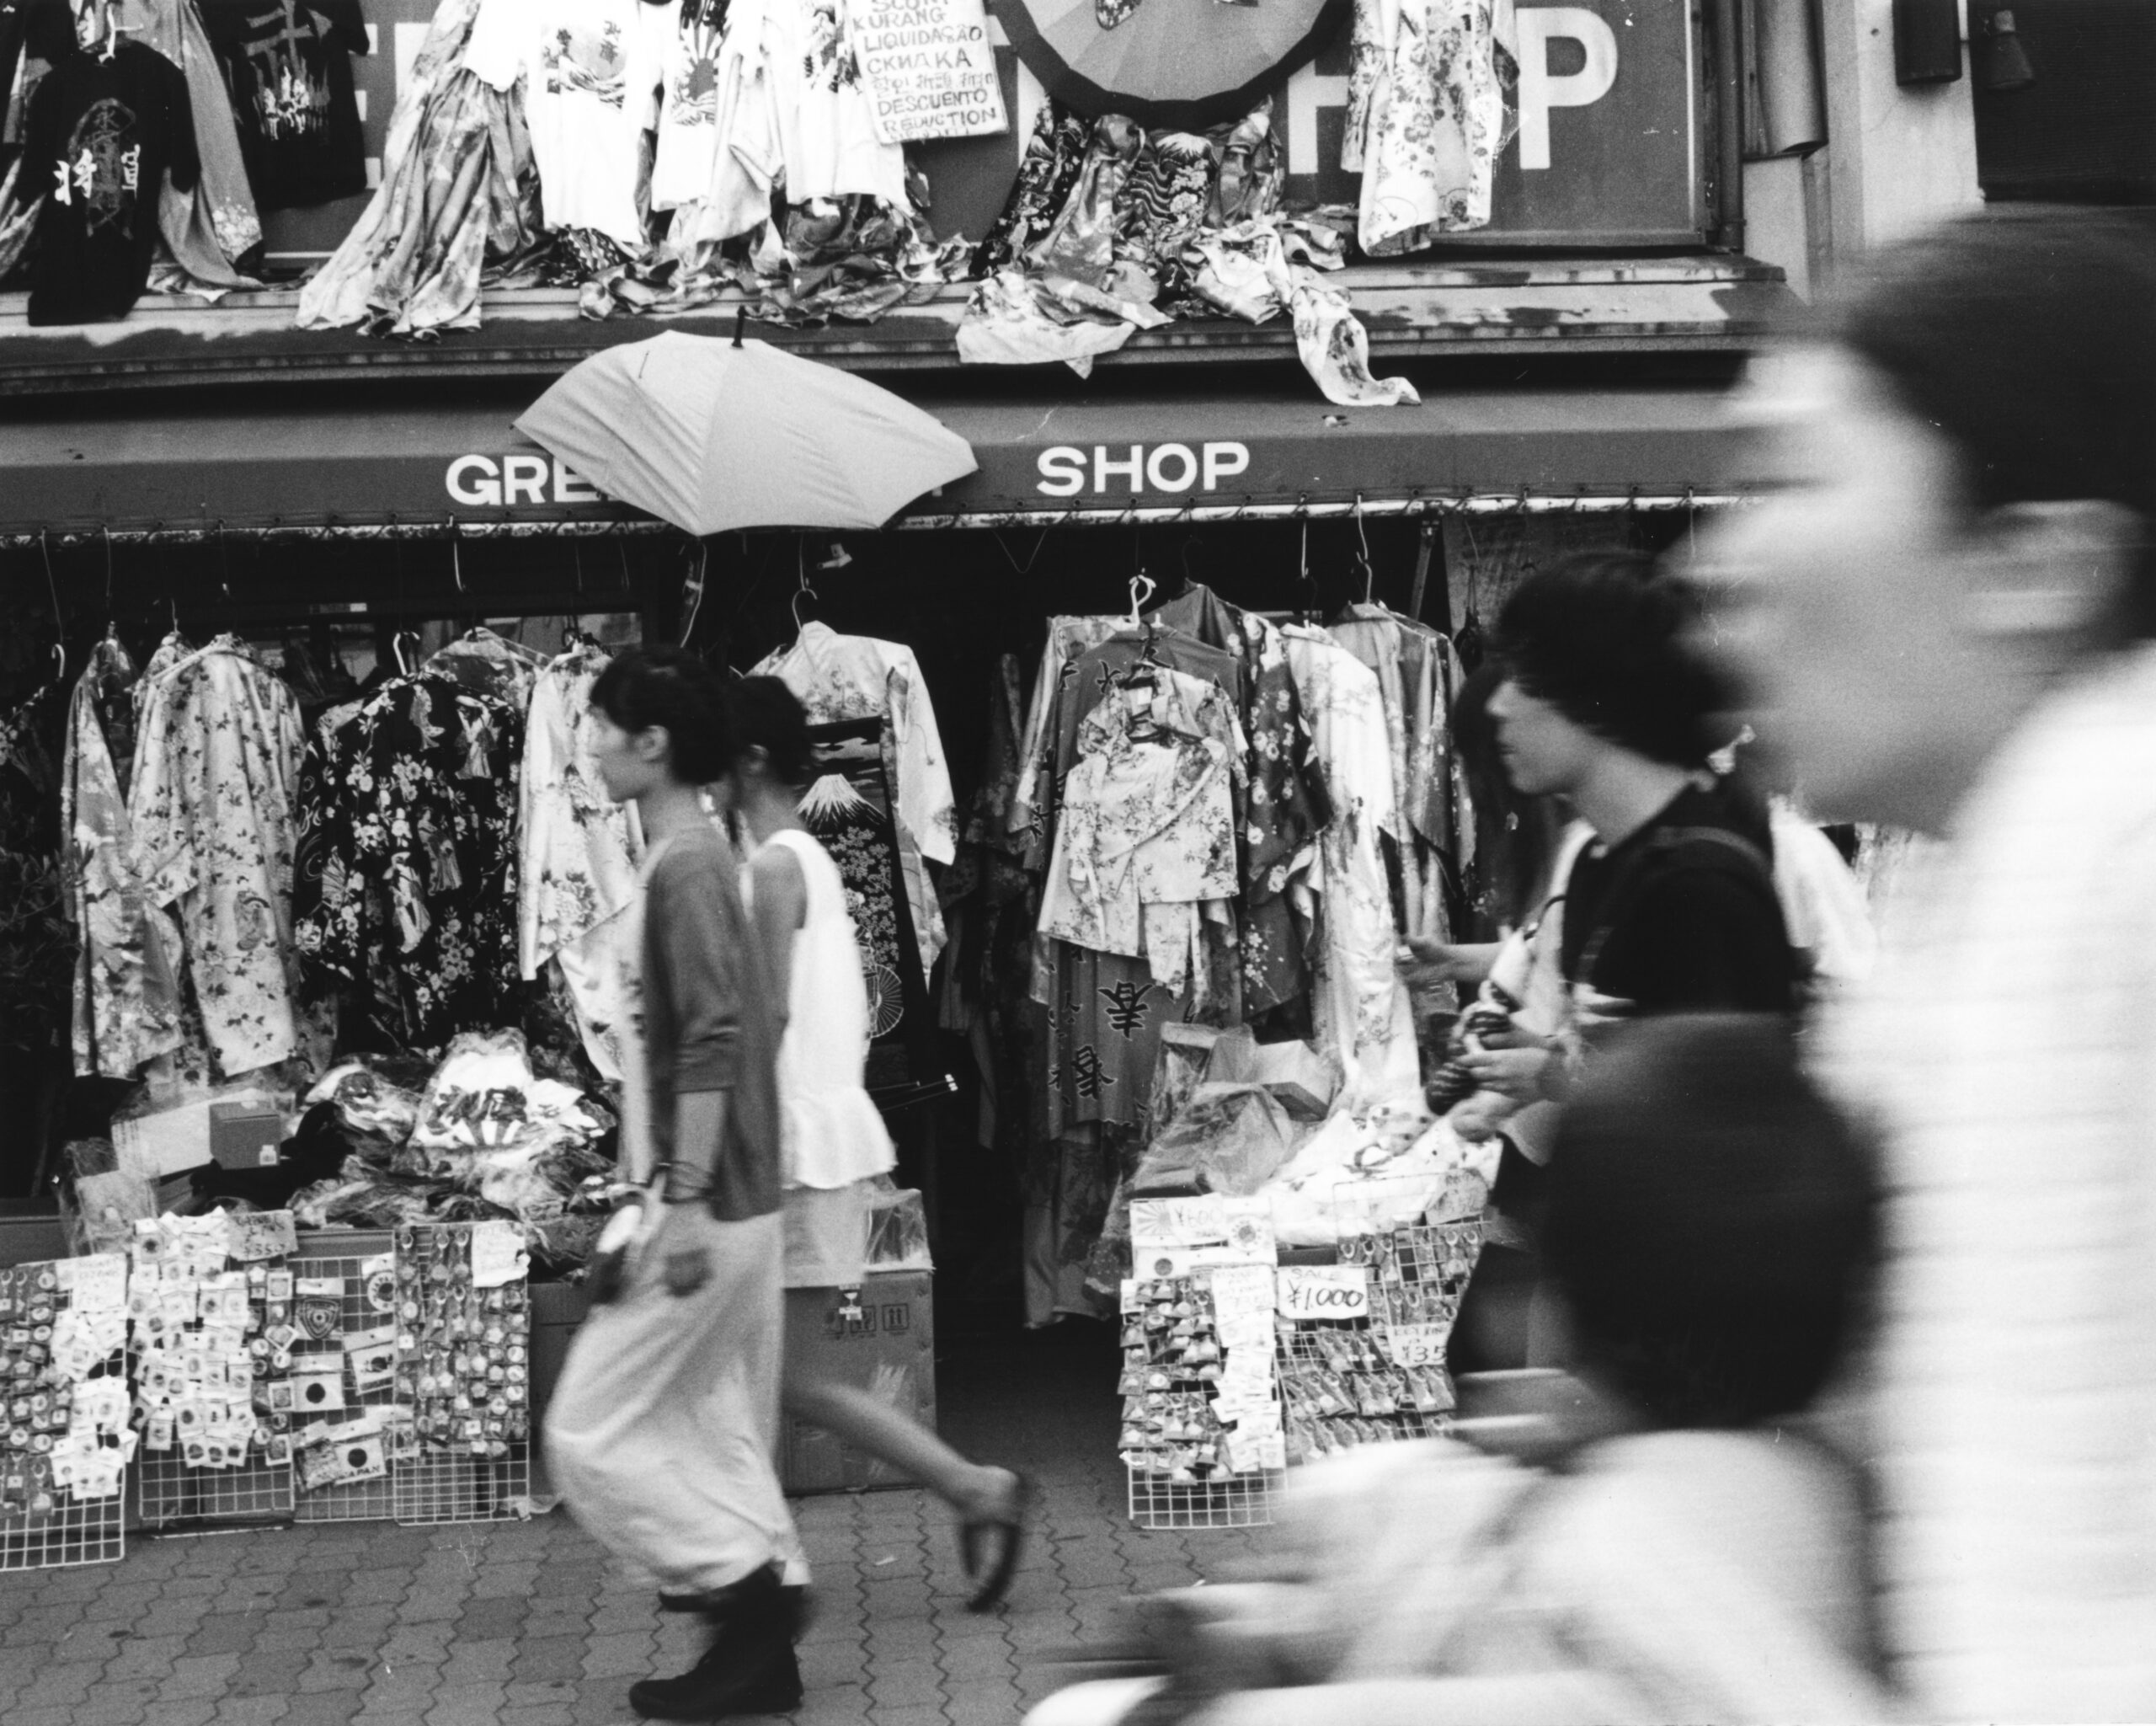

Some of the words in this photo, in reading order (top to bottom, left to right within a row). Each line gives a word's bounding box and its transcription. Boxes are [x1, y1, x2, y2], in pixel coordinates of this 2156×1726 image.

[852, 7, 947, 32] KURANG
[878, 88, 988, 116] DESCUENTO
[1036, 441, 1250, 497] SHOP
